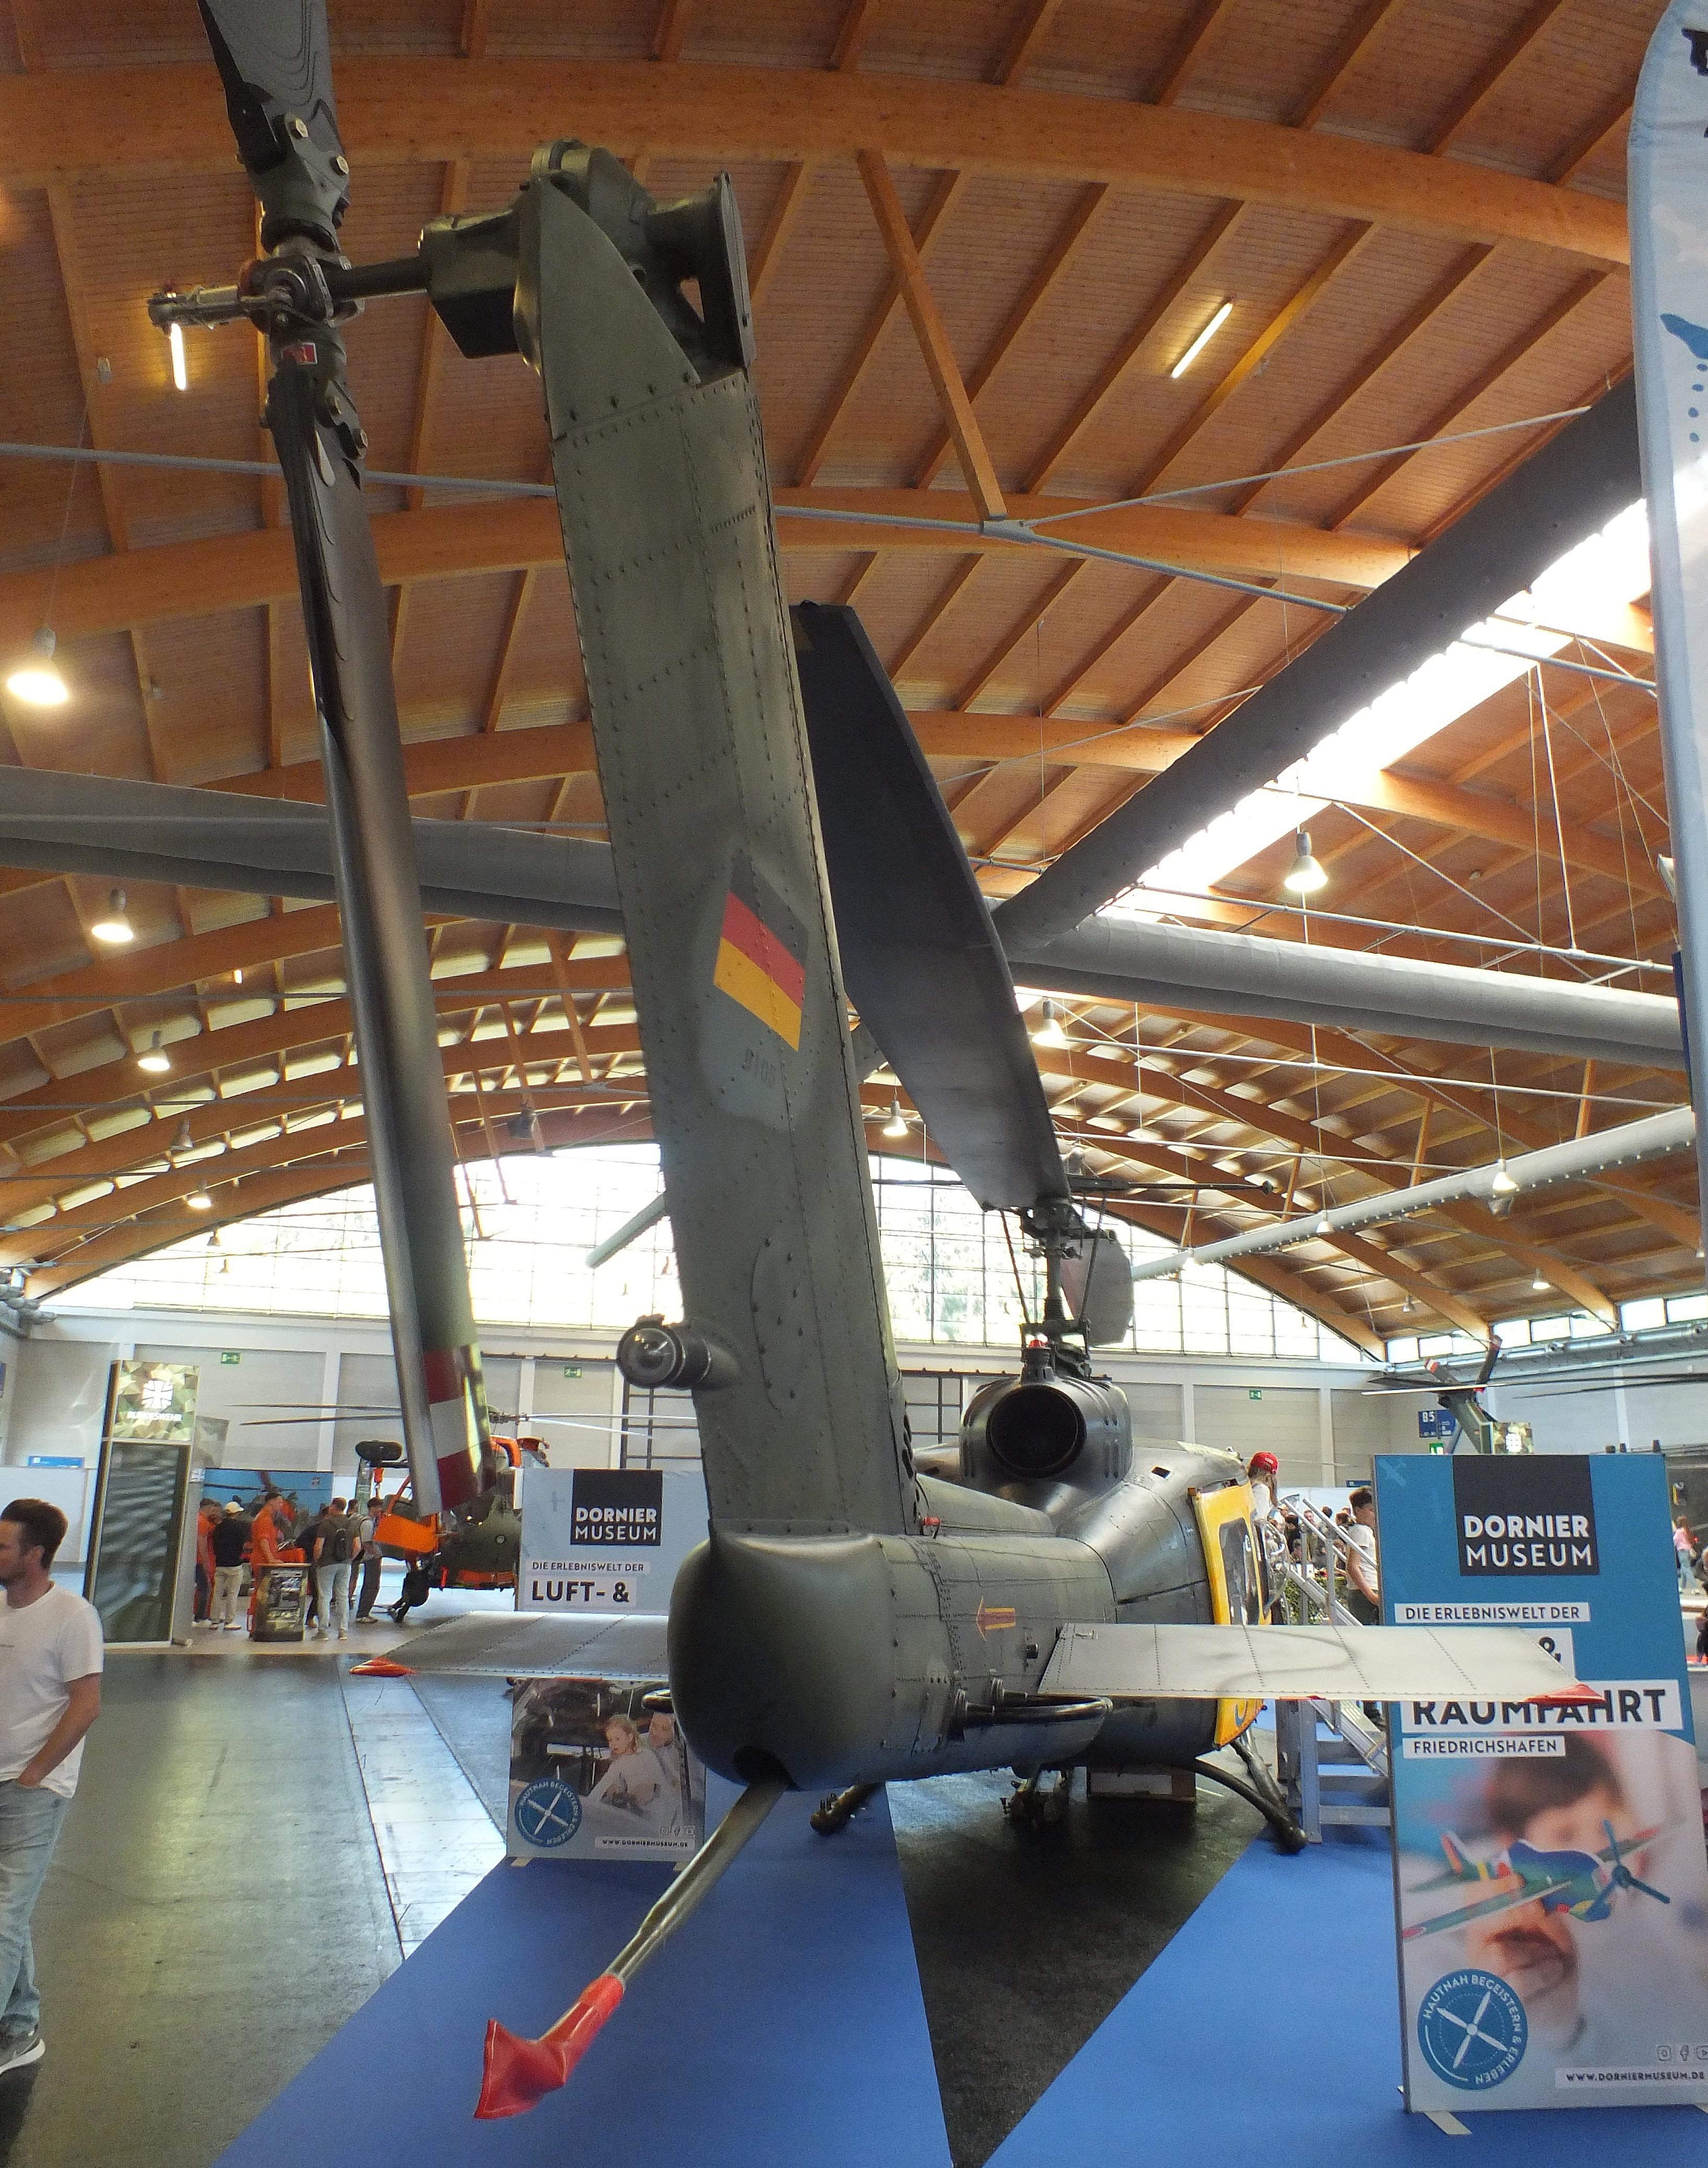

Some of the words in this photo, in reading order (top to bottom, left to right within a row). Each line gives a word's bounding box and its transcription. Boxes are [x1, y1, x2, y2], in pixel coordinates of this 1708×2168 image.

[576, 1507, 656, 1523] DORNIER
[575, 1526, 656, 1540] MUSEUM
[1464, 1515, 1589, 1538] DORNIER
[1467, 1543, 1593, 1567] MUSEUM
[551, 1562, 622, 1571] ERLEBNISWELT
[532, 1580, 605, 1602] LUFT-
[613, 1582, 629, 1602] &
[1405, 1607, 1430, 1619] DIE
[1435, 1607, 1545, 1619] ERLEBNISWELT
[1550, 1607, 1580, 1619] DER
[1414, 1740, 1557, 1753] FRIEDRICHSHAFEN
[1423, 1975, 1469, 2019] HAUTNAH
[1471, 1975, 1521, 2032] BEGEISTERN
[1475, 2046, 1519, 2084] ERLEBEN
[1566, 2071, 1705, 2082] WWW.DORNIERMUSEUM.DE
